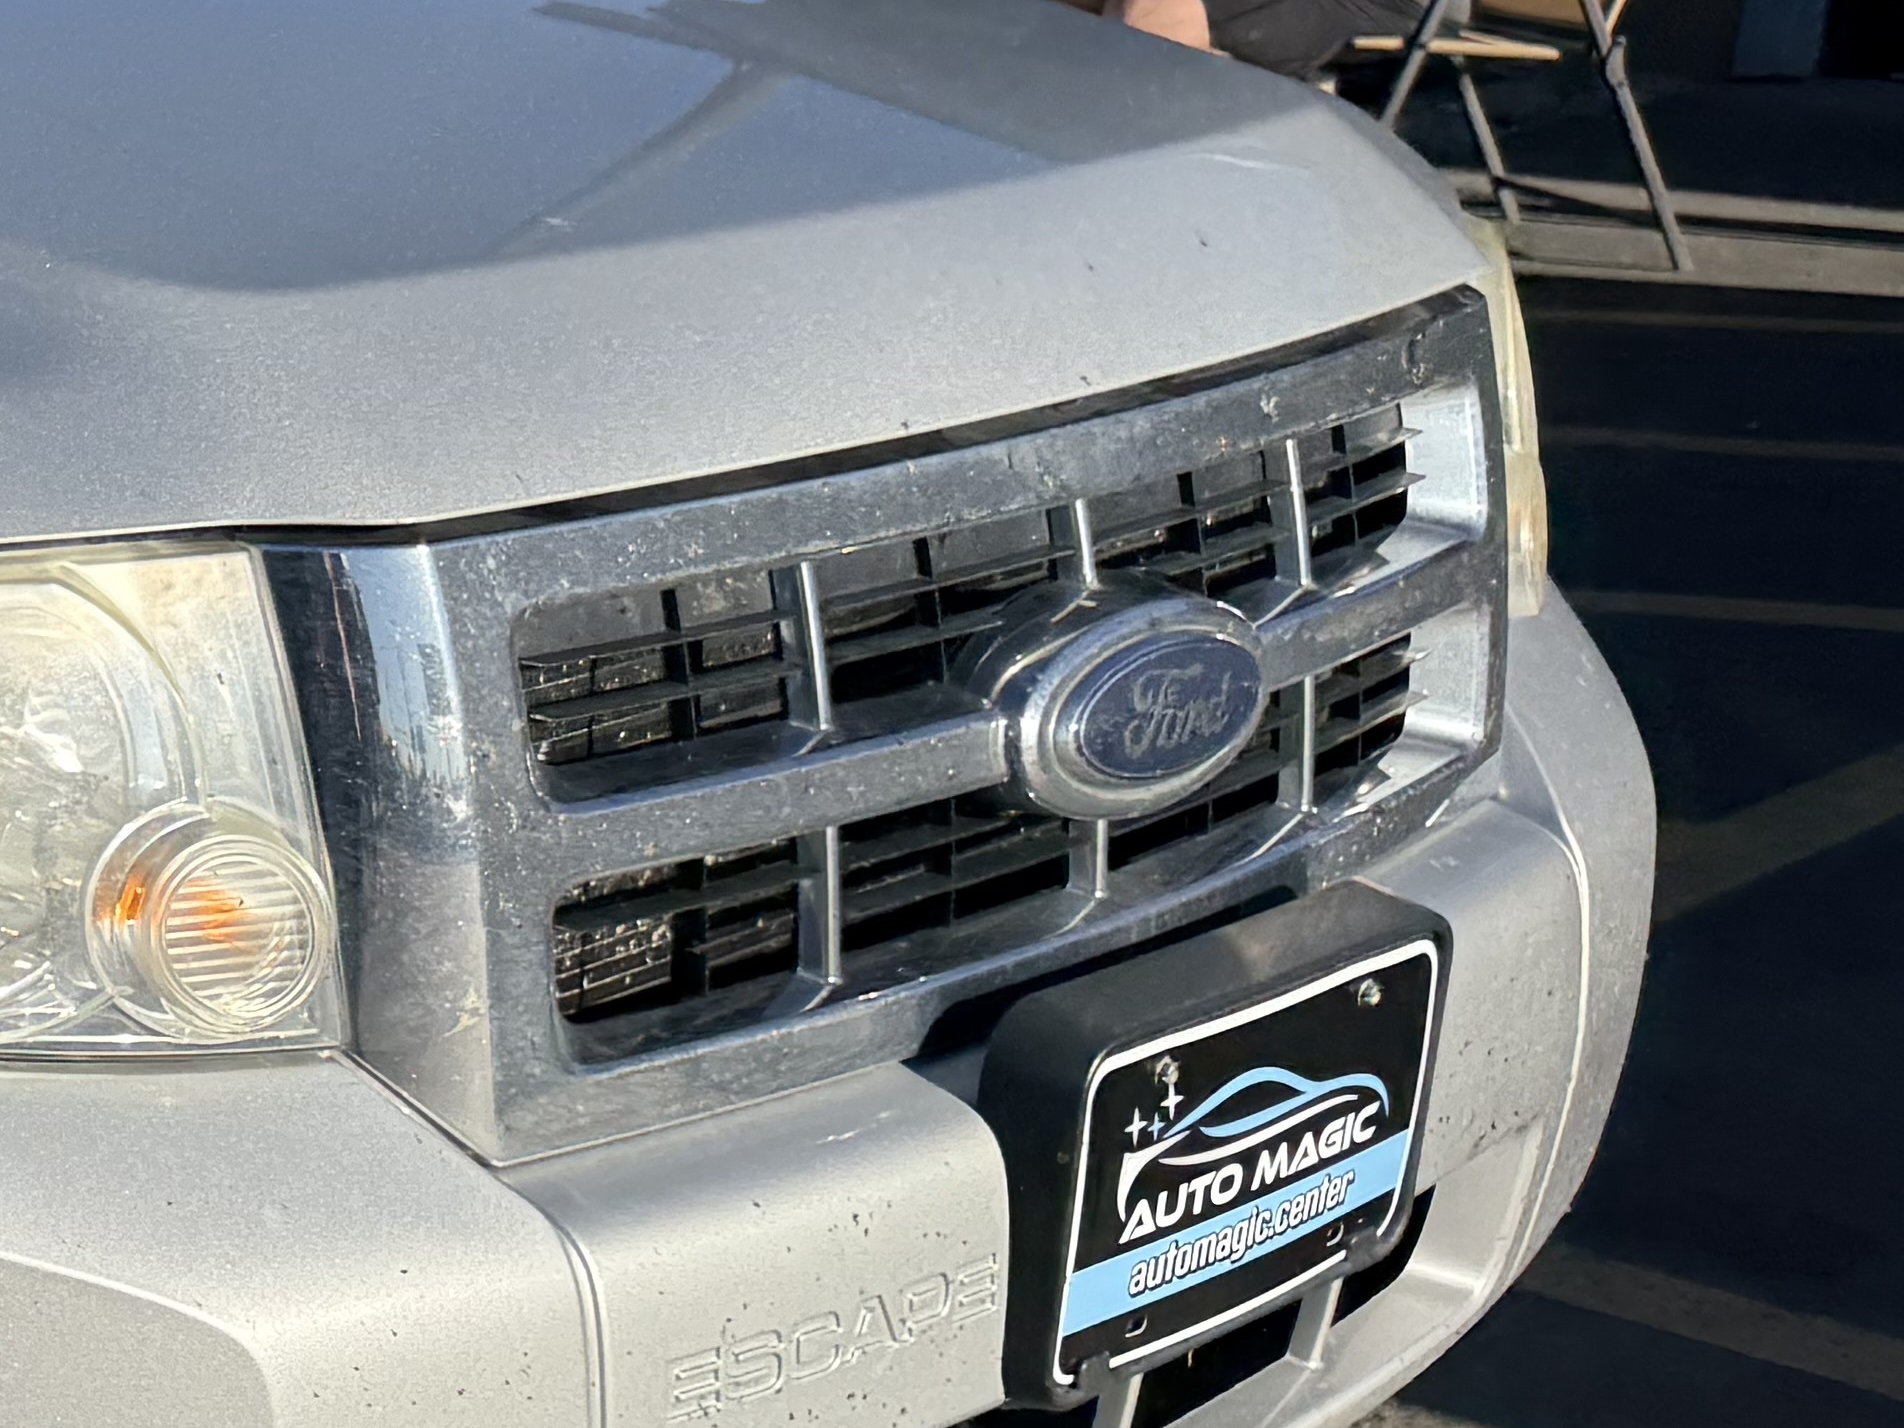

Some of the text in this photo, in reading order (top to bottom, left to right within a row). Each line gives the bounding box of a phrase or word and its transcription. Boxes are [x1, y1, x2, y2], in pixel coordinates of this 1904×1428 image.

[1123, 662, 1233, 760] Ford
[1118, 1100, 1382, 1245] AUTO MAGIC
[1127, 1168, 1356, 1299] automagic.center
[666, 1251, 998, 1422] ESCAPE
